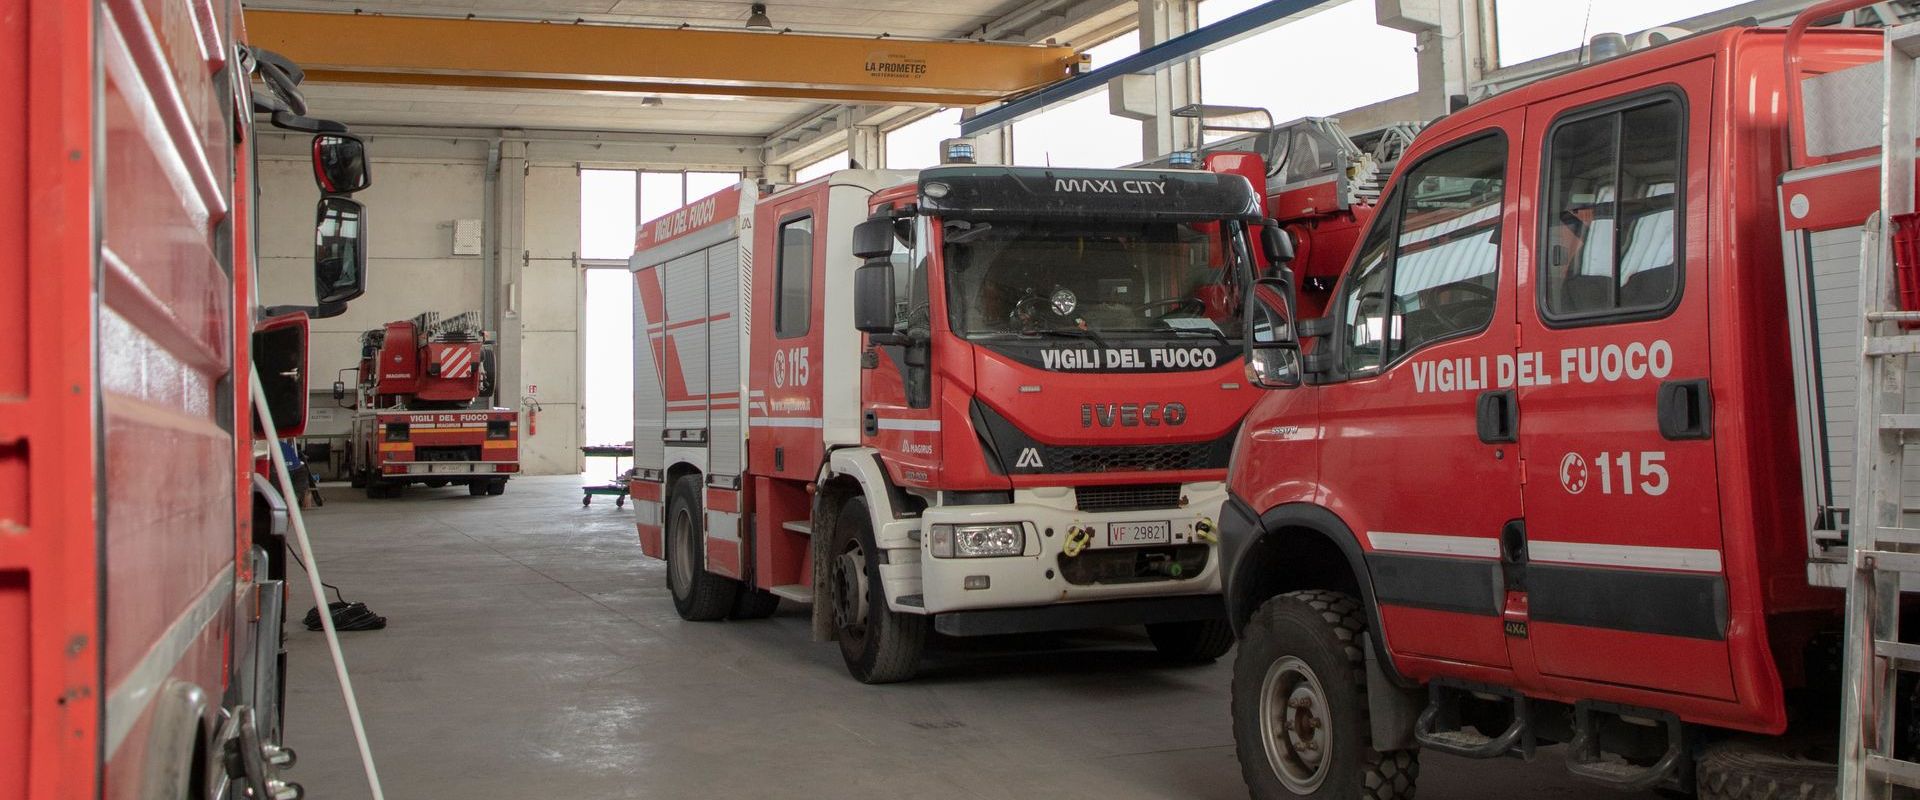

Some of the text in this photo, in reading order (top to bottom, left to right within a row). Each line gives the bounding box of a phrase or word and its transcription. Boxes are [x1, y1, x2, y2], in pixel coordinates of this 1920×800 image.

[865, 62, 927, 74] LA PROMETEC
[1055, 178, 1166, 194] MAXI CITY
[654, 197, 716, 243] VIGILI DEL FUOCO
[789, 346, 809, 387] 115
[1040, 347, 1217, 369] VIGILI DEL FUOCO
[1412, 340, 1673, 393] VIGILI DEL FUOCO
[1081, 401, 1187, 428] IVECO
[910, 444, 933, 454] MAGIRUS
[1595, 451, 1670, 496] 115
[1113, 525, 1165, 541] VF 29821
